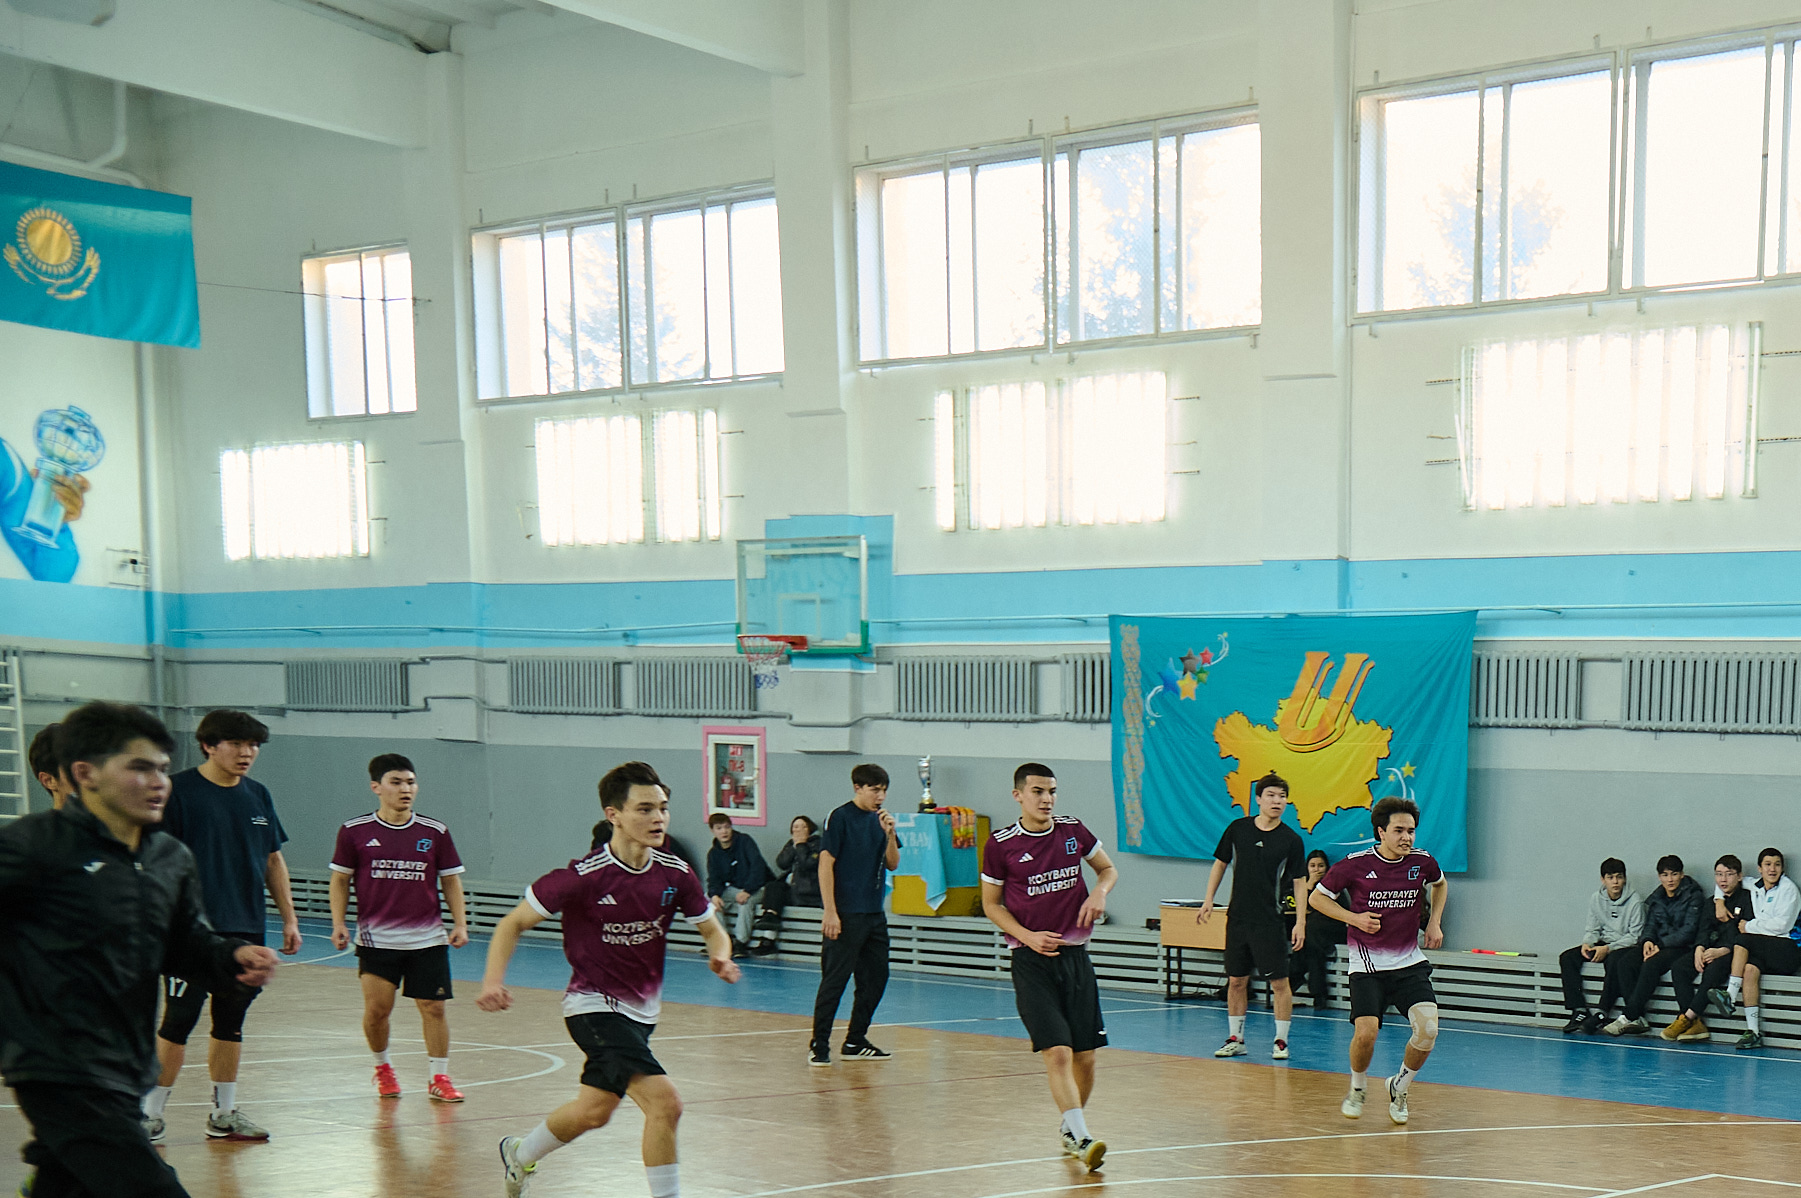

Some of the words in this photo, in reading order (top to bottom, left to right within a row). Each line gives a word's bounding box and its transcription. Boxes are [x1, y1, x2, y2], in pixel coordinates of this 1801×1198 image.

[1369, 889, 1419, 900] KOZYBAYEV
[1367, 899, 1417, 909] UNIVERSITY
[169, 976, 188, 998] 17
